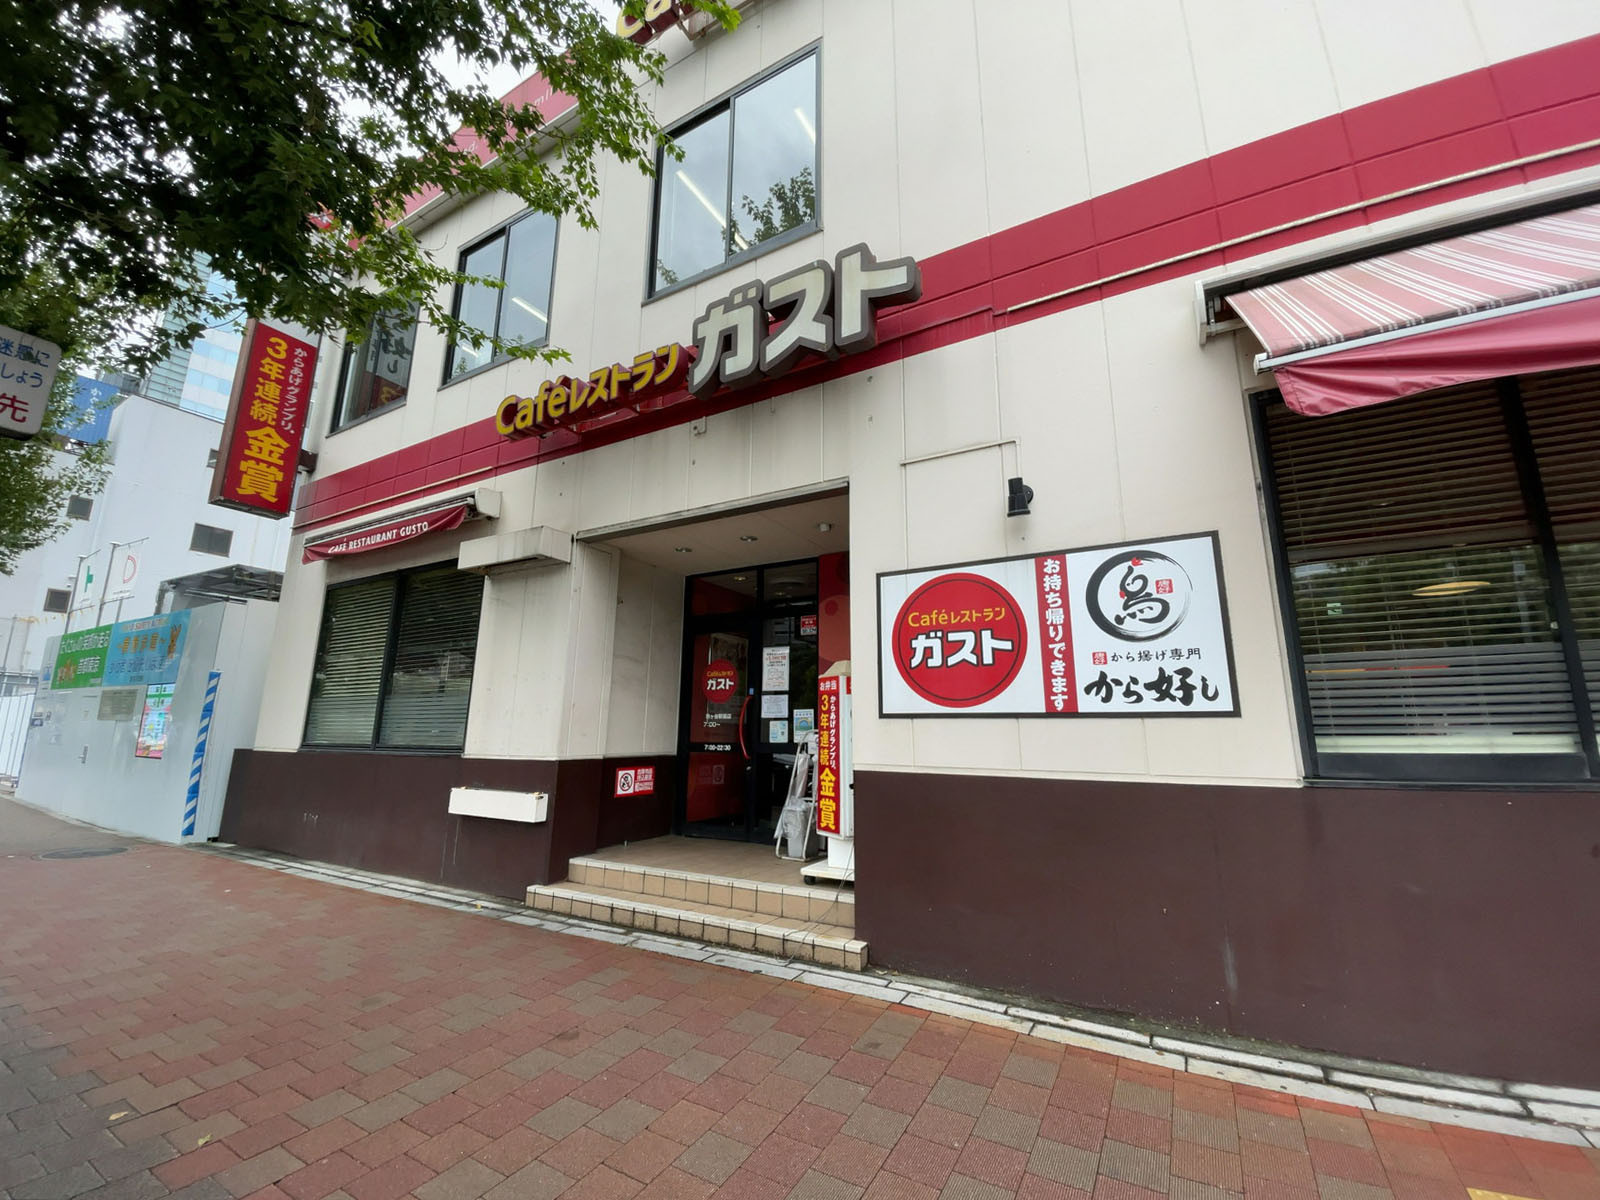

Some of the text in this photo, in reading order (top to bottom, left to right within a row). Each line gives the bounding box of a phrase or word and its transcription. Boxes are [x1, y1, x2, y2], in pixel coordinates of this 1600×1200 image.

[496, 244, 918, 435] Caféレストラン ガスト
[349, 529, 398, 549] RESTAURANT
[400, 521, 429, 537] GUSTO
[908, 608, 1006, 628] Caféレストラン
[1043, 559, 1069, 711] お持ち帰りできます
[910, 629, 1014, 669] ガスト
[1111, 648, 1202, 662] から揚げ専門
[706, 679, 735, 691] ガスト
[1084, 666, 1219, 706] から好し
